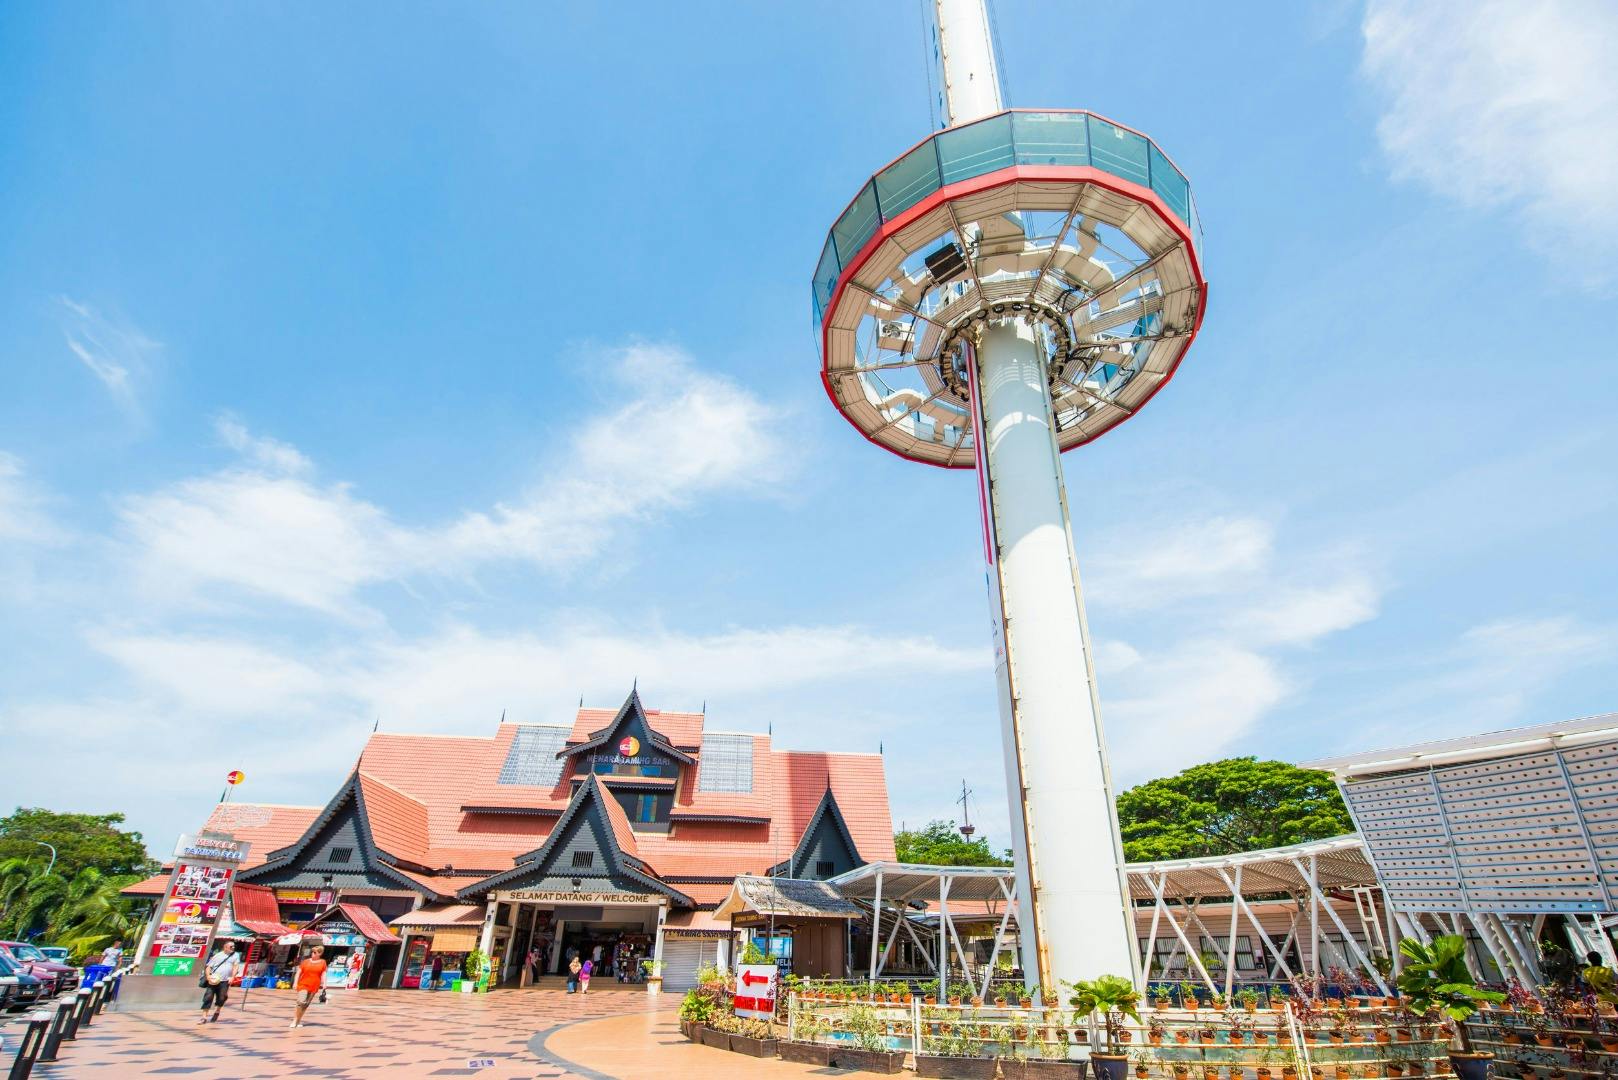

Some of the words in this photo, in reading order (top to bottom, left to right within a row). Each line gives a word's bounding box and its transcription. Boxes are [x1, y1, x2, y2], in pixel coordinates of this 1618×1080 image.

[587, 754, 620, 765] MENARA
[652, 757, 671, 766] SARI
[510, 892, 554, 900] SELAMAT
[555, 893, 593, 901] DATANG
[602, 894, 649, 903] WELCOME
